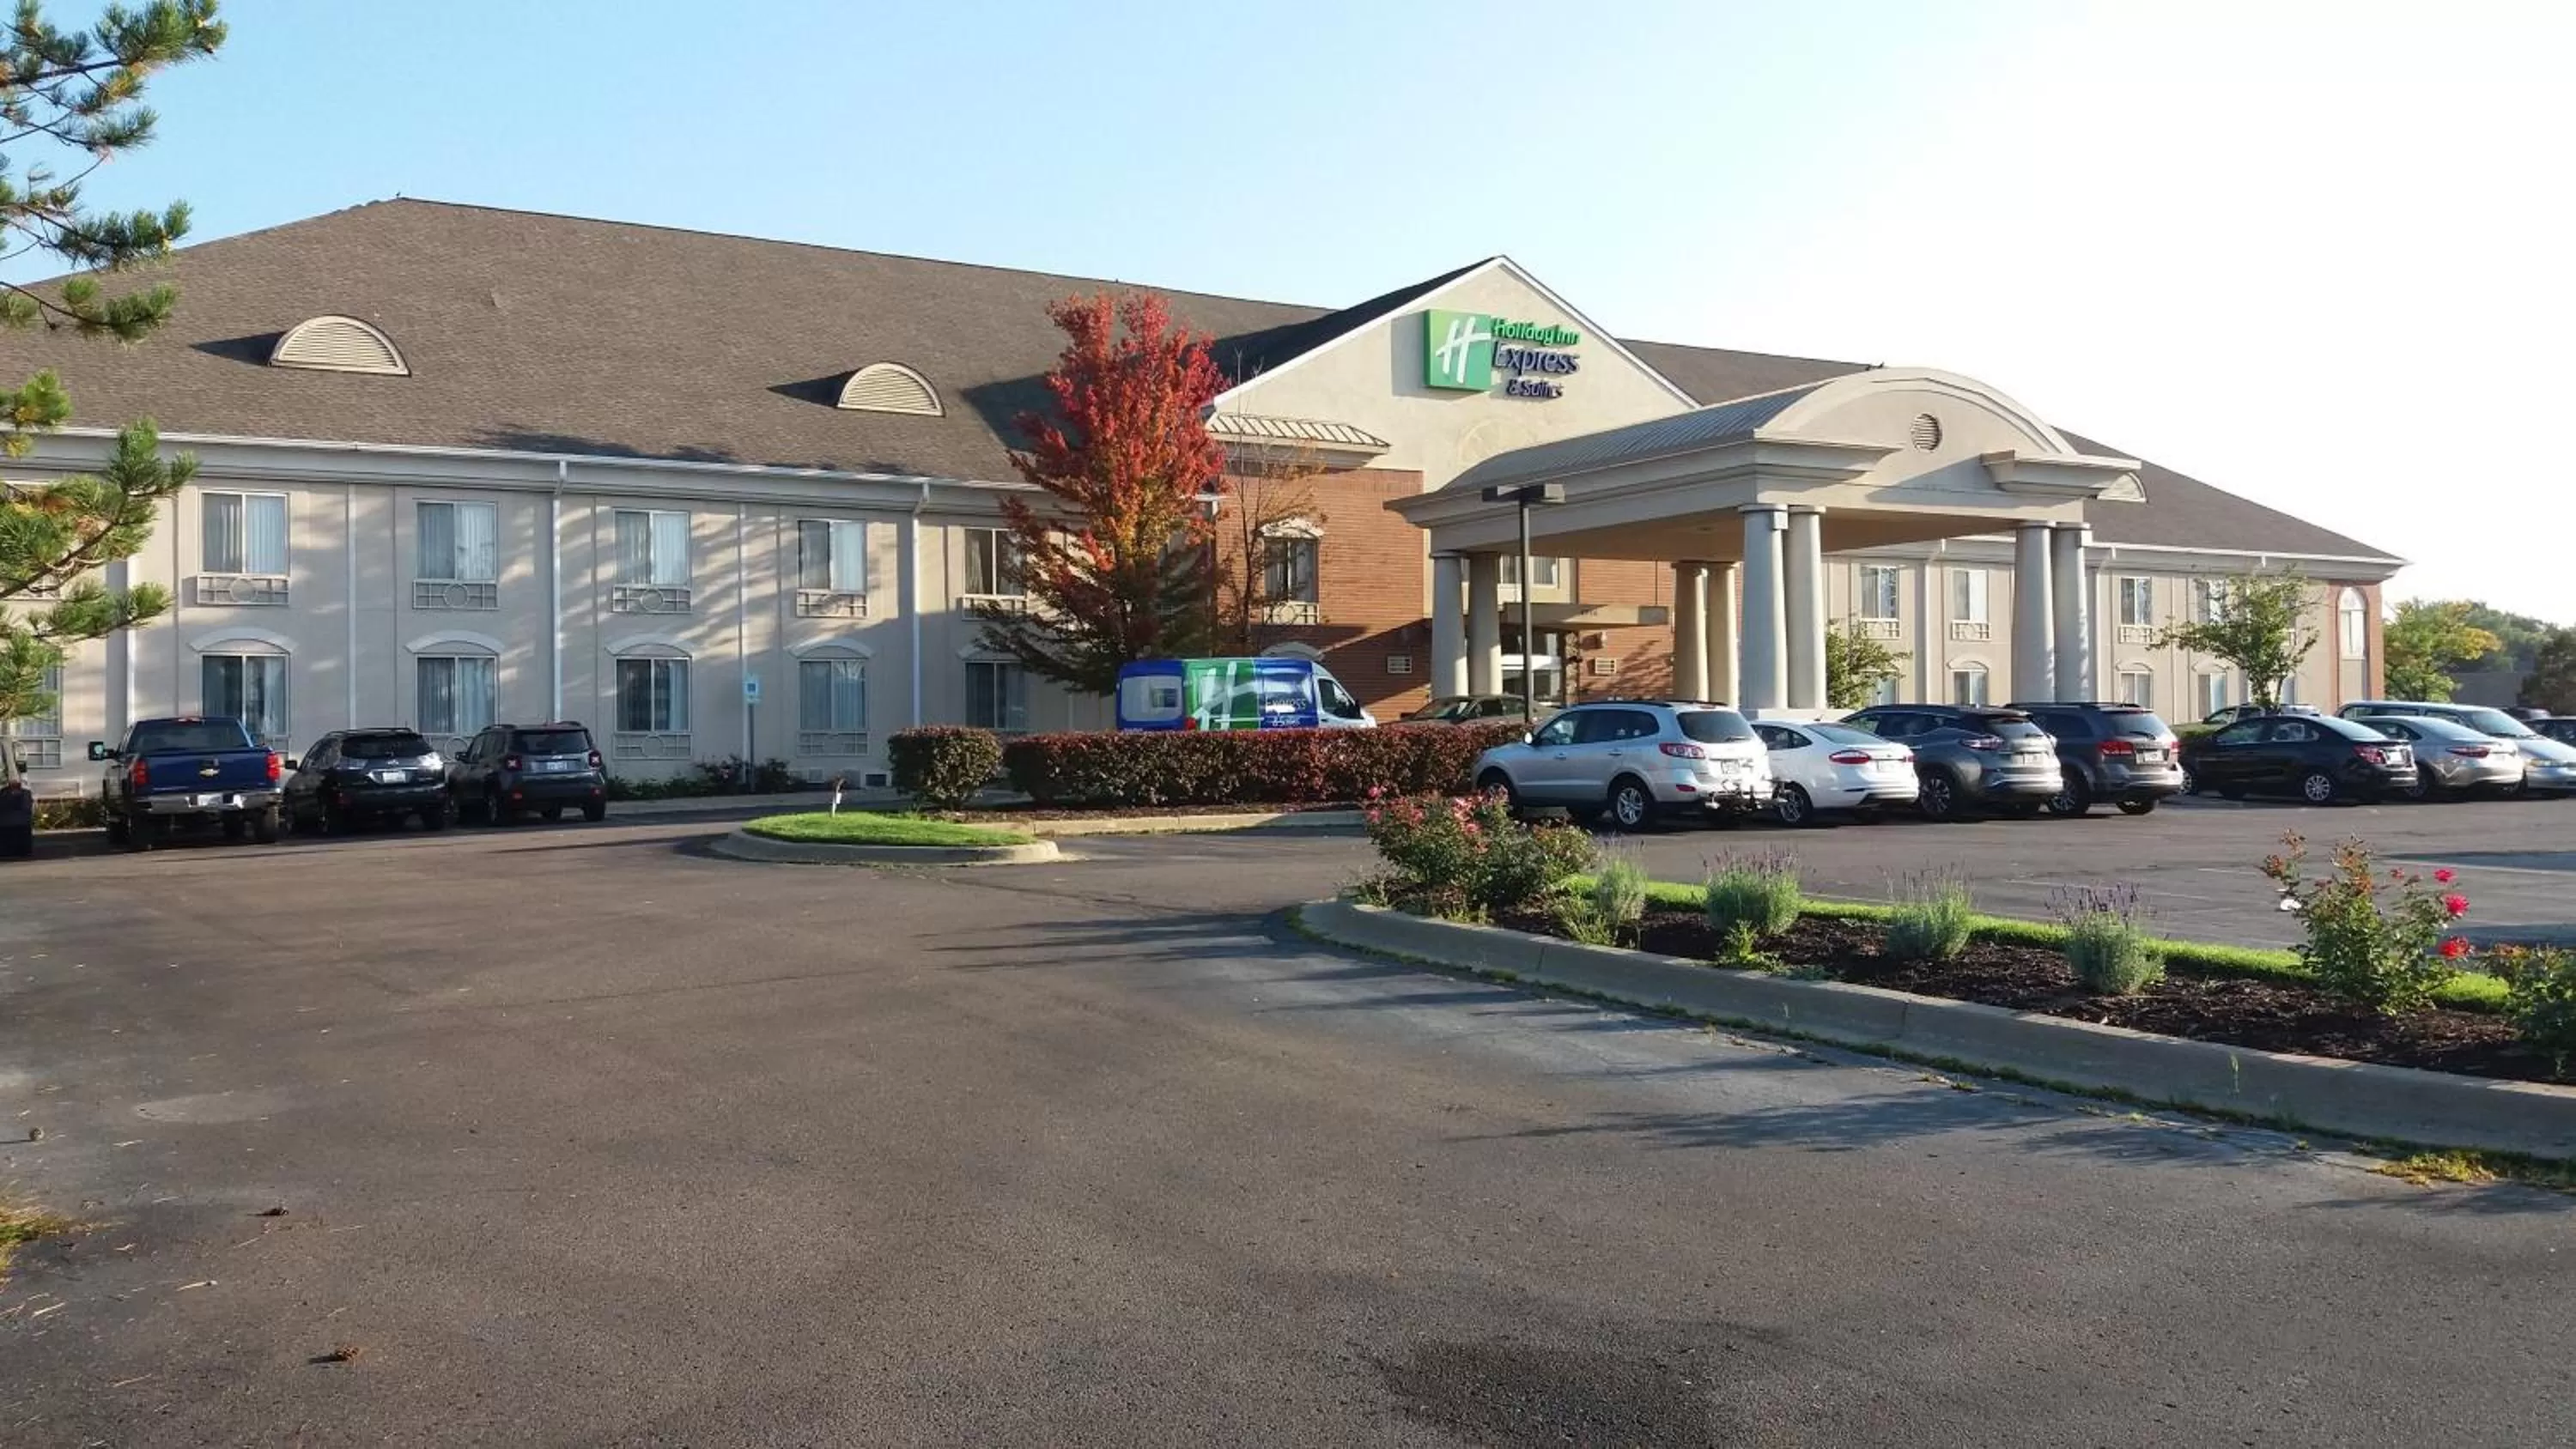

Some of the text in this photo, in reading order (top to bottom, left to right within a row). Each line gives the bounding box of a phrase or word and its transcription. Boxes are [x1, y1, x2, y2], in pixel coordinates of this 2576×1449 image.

[1492, 318, 1579, 346] Holiday Inn
[1493, 341, 1580, 376] Express
[1507, 379, 1519, 395] &
